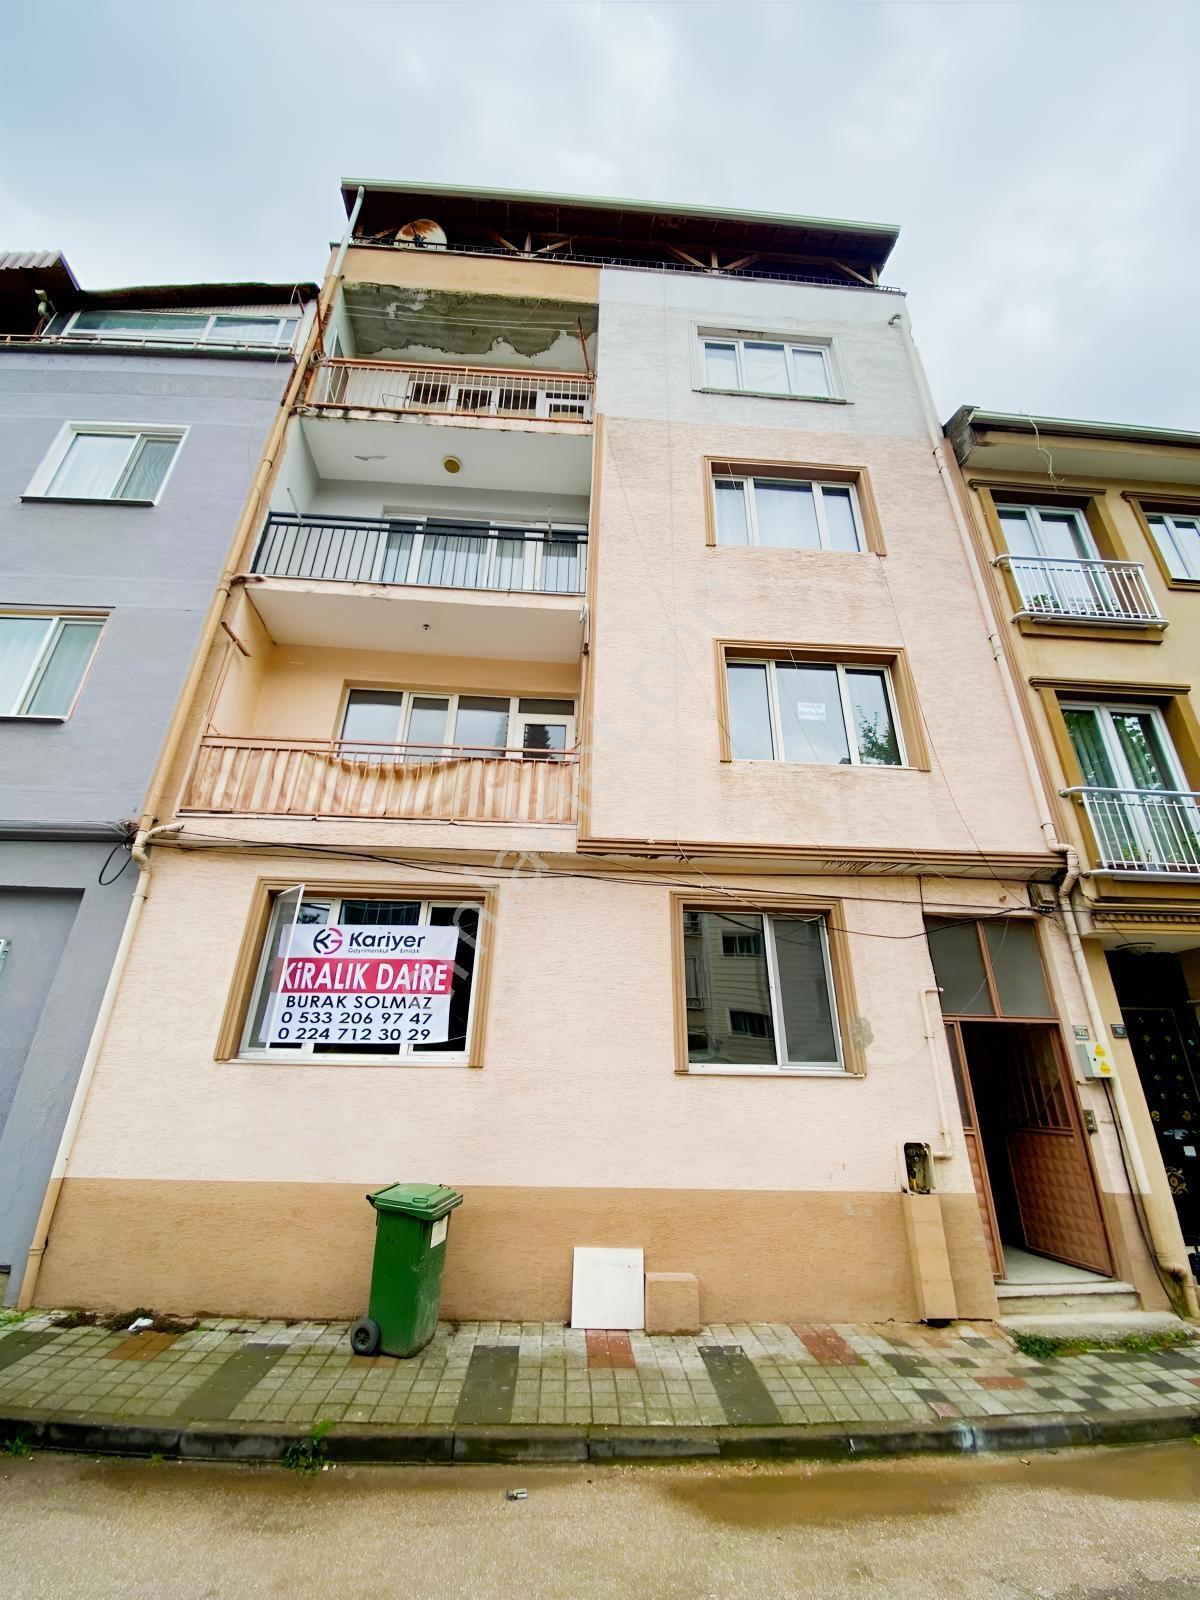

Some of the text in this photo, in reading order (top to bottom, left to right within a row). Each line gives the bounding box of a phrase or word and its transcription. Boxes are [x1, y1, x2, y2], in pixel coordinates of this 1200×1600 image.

[349, 931, 426, 951] Kariyer
[286, 995, 433, 1010] BURAK SOLMAZ
[281, 1012, 433, 1025] 0 533 206 97 47
[278, 1027, 431, 1041] 0 224 712 30 29
